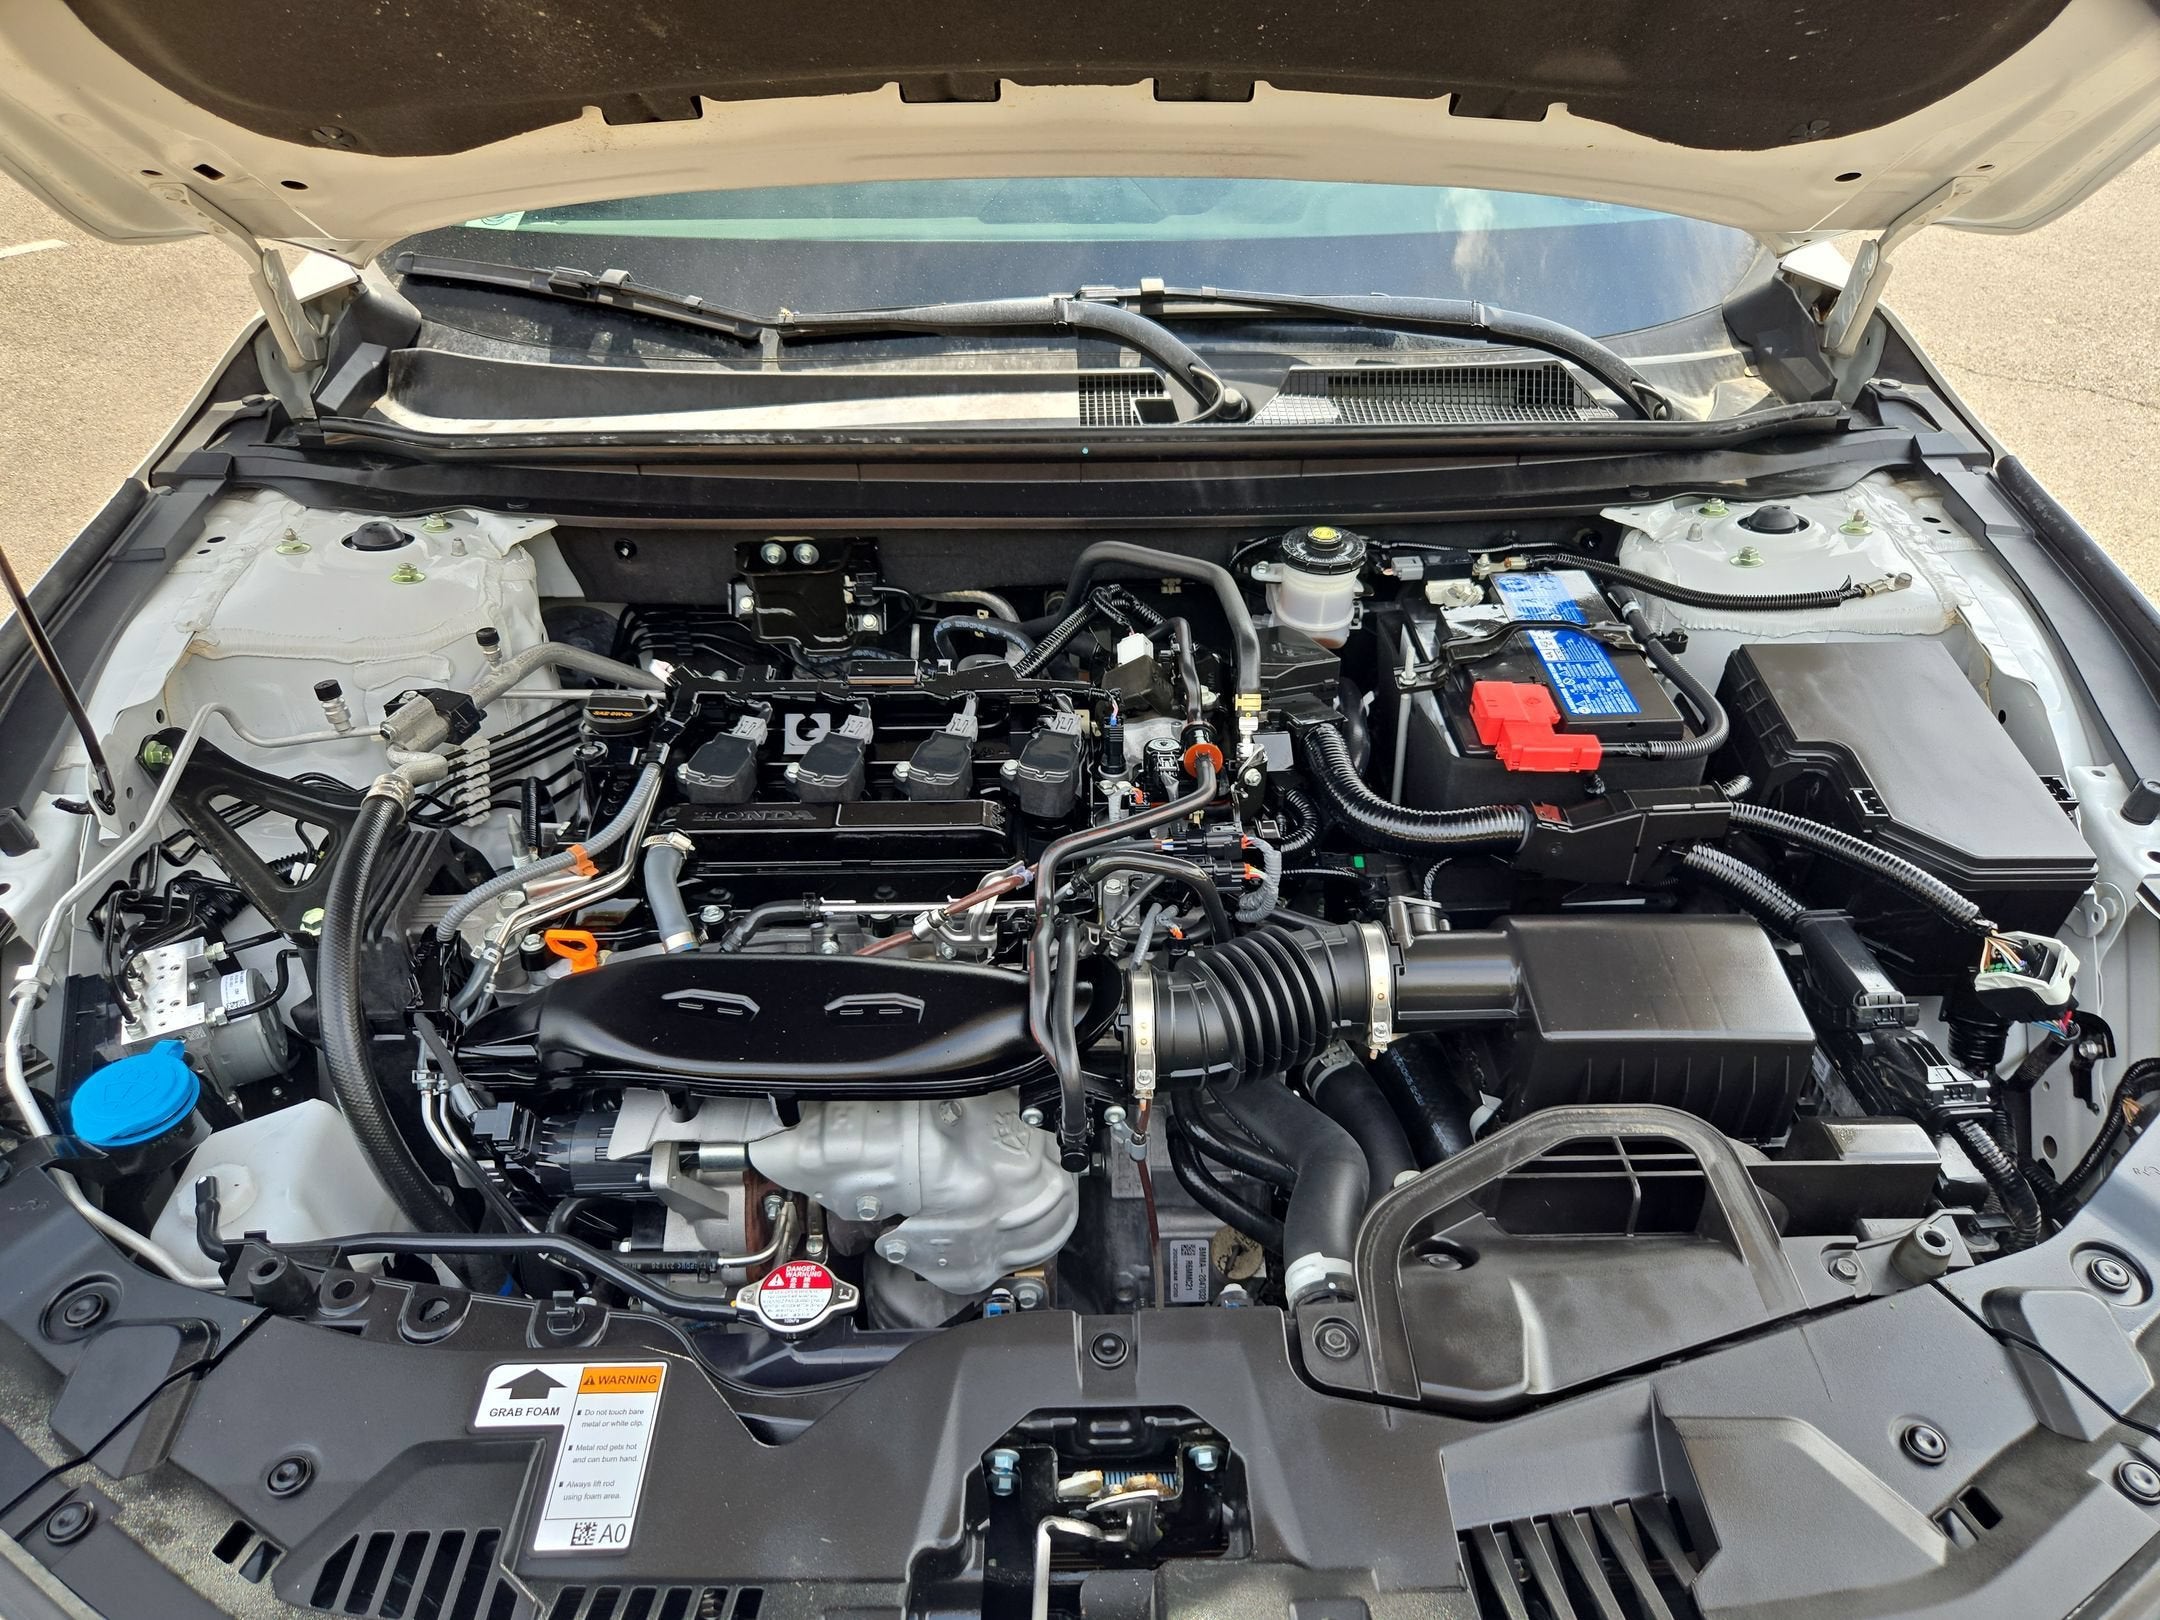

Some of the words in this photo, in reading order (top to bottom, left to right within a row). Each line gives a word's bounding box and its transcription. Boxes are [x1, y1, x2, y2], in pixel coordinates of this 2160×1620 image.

[692, 810, 817, 822] HONDA
[785, 1270, 823, 1278] WARNUNG
[598, 1374, 657, 1385] WARNING
[489, 1407, 523, 1417] GRAB
[525, 1406, 560, 1417] FOAM
[582, 1420, 600, 1428] metal
[630, 1419, 644, 1428] clip.
[596, 1443, 609, 1451] rod
[609, 1443, 625, 1452] gets
[601, 1455, 618, 1463] burn
[565, 1480, 591, 1489] Always
[602, 1479, 615, 1487] rod
[563, 1493, 583, 1502] using
[583, 1492, 602, 1500] foam
[598, 1523, 627, 1544] A0
